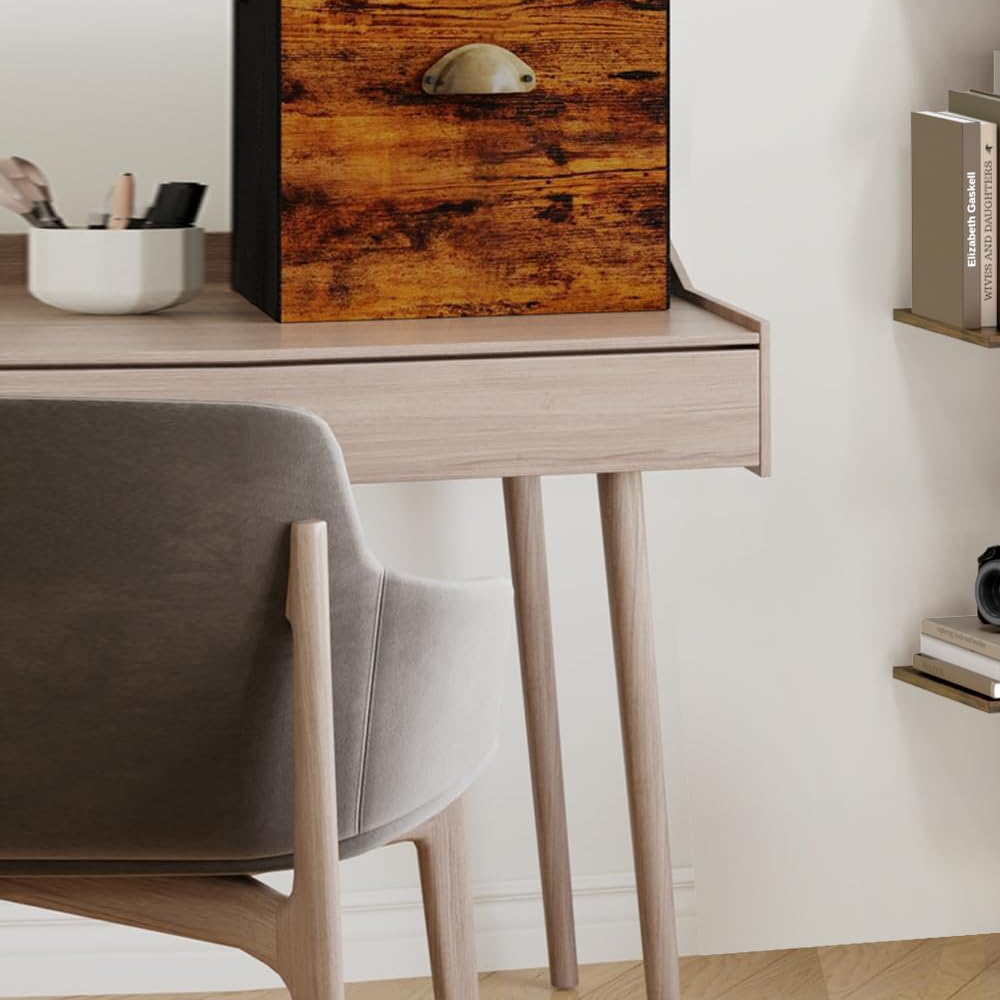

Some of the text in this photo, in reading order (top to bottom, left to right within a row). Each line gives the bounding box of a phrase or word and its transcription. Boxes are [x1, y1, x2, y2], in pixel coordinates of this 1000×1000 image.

[967, 172, 977, 267] Elizabeth Gaskell
[984, 160, 993, 301] WIVES AND DAUGHTERS
